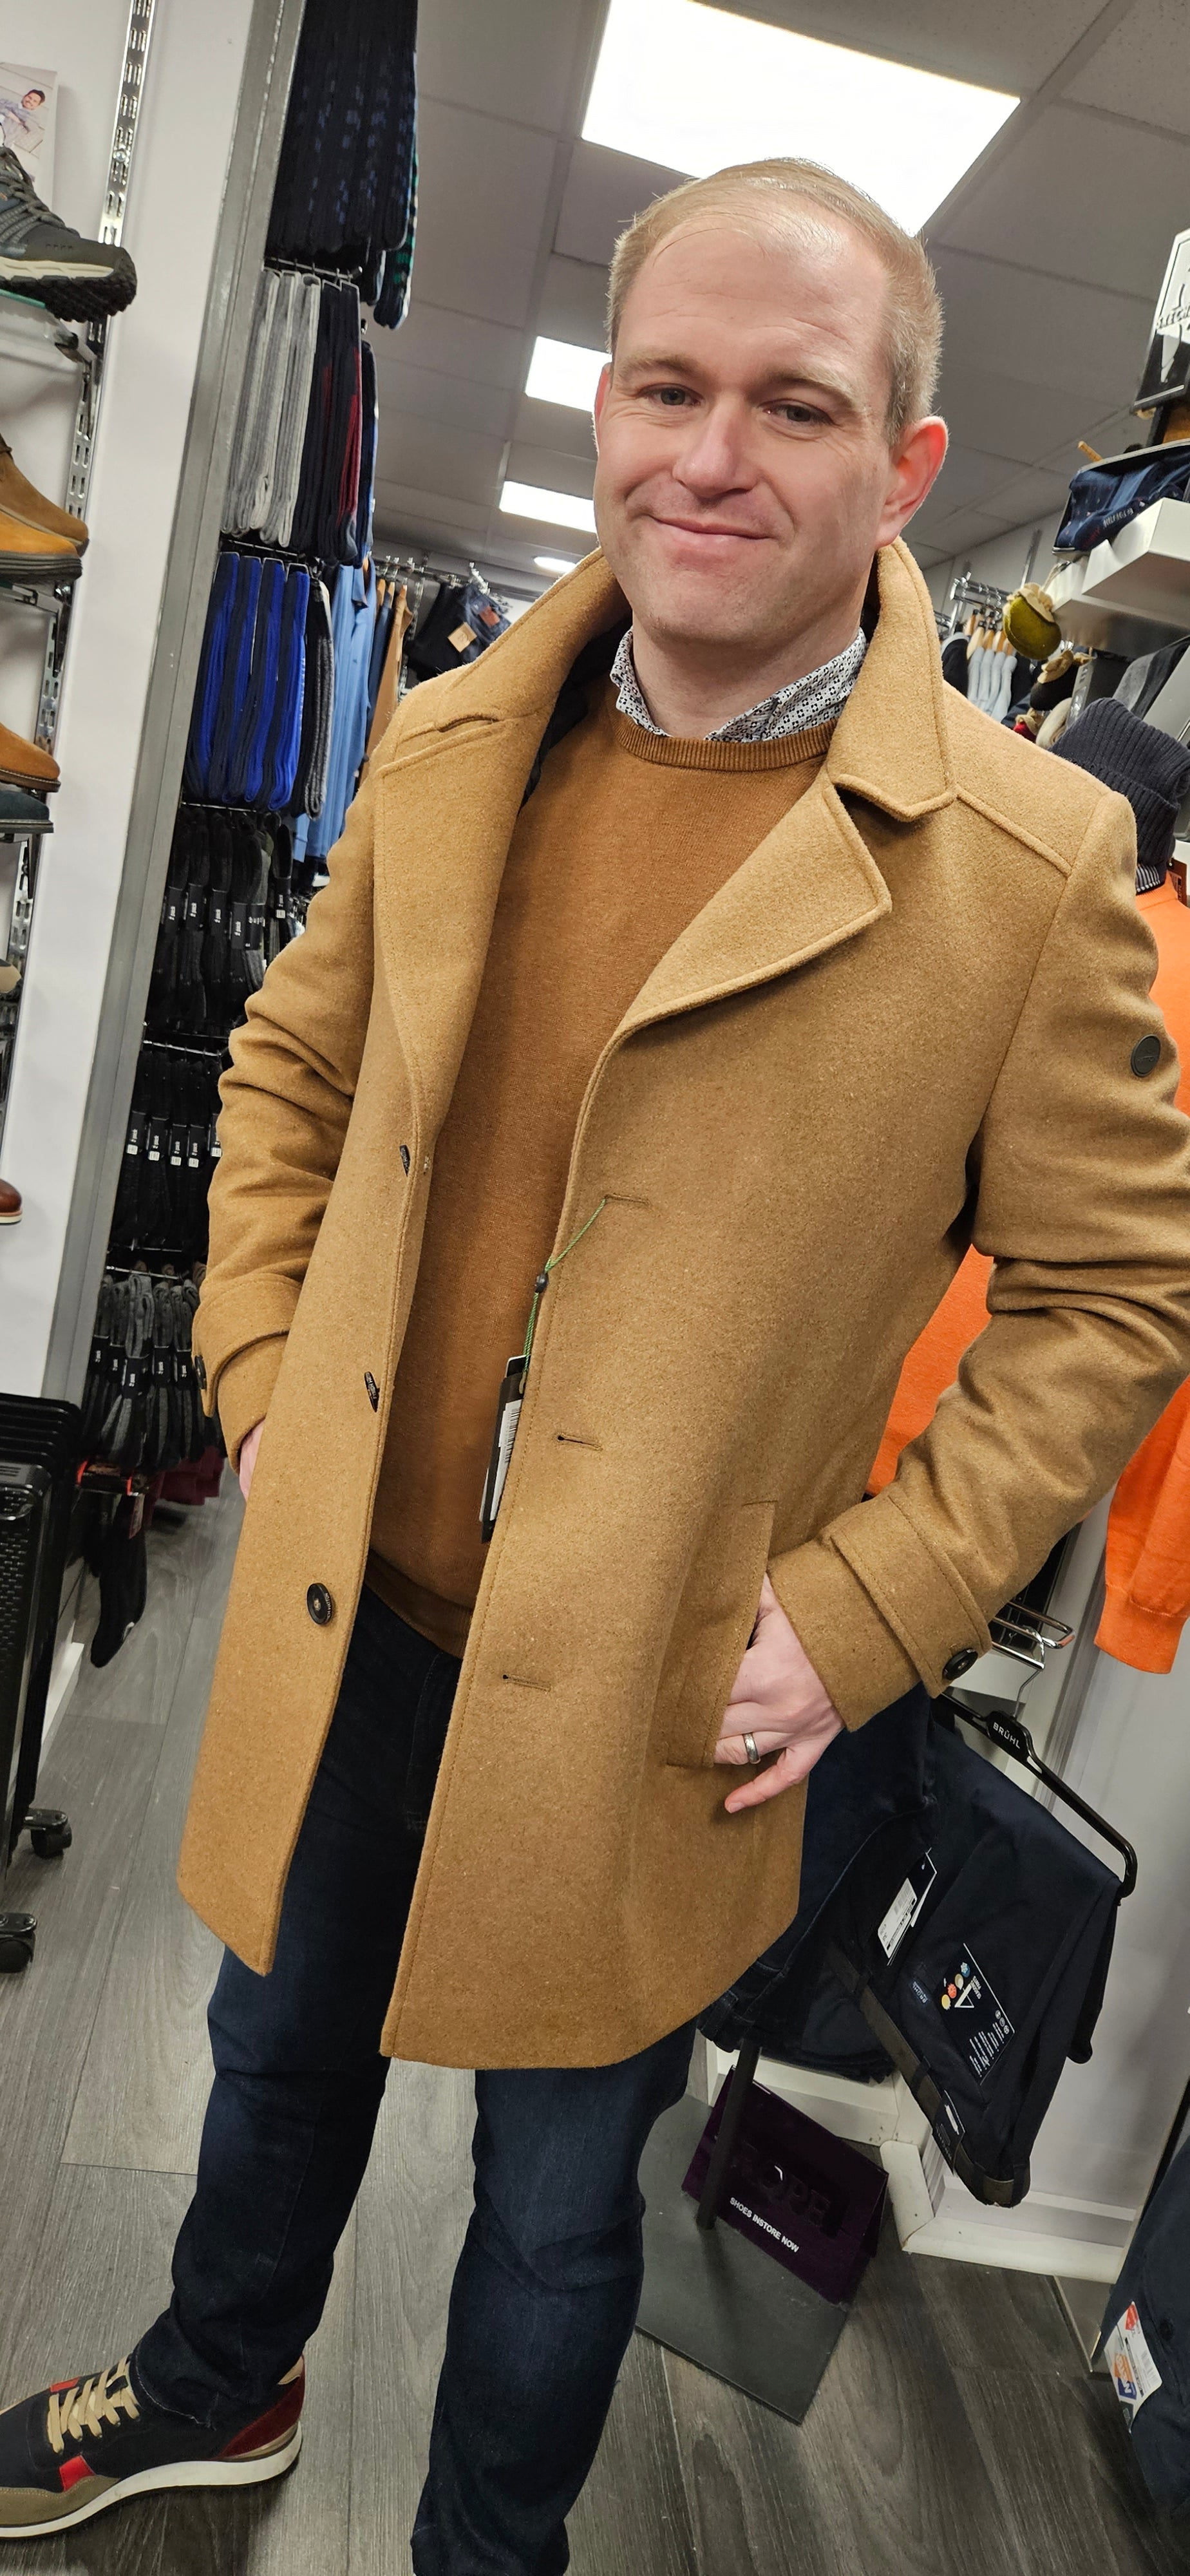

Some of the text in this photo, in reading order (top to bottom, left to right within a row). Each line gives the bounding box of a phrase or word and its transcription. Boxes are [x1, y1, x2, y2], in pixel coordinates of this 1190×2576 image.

[730, 2197, 800, 2253] SHOES INSTORE NOW
